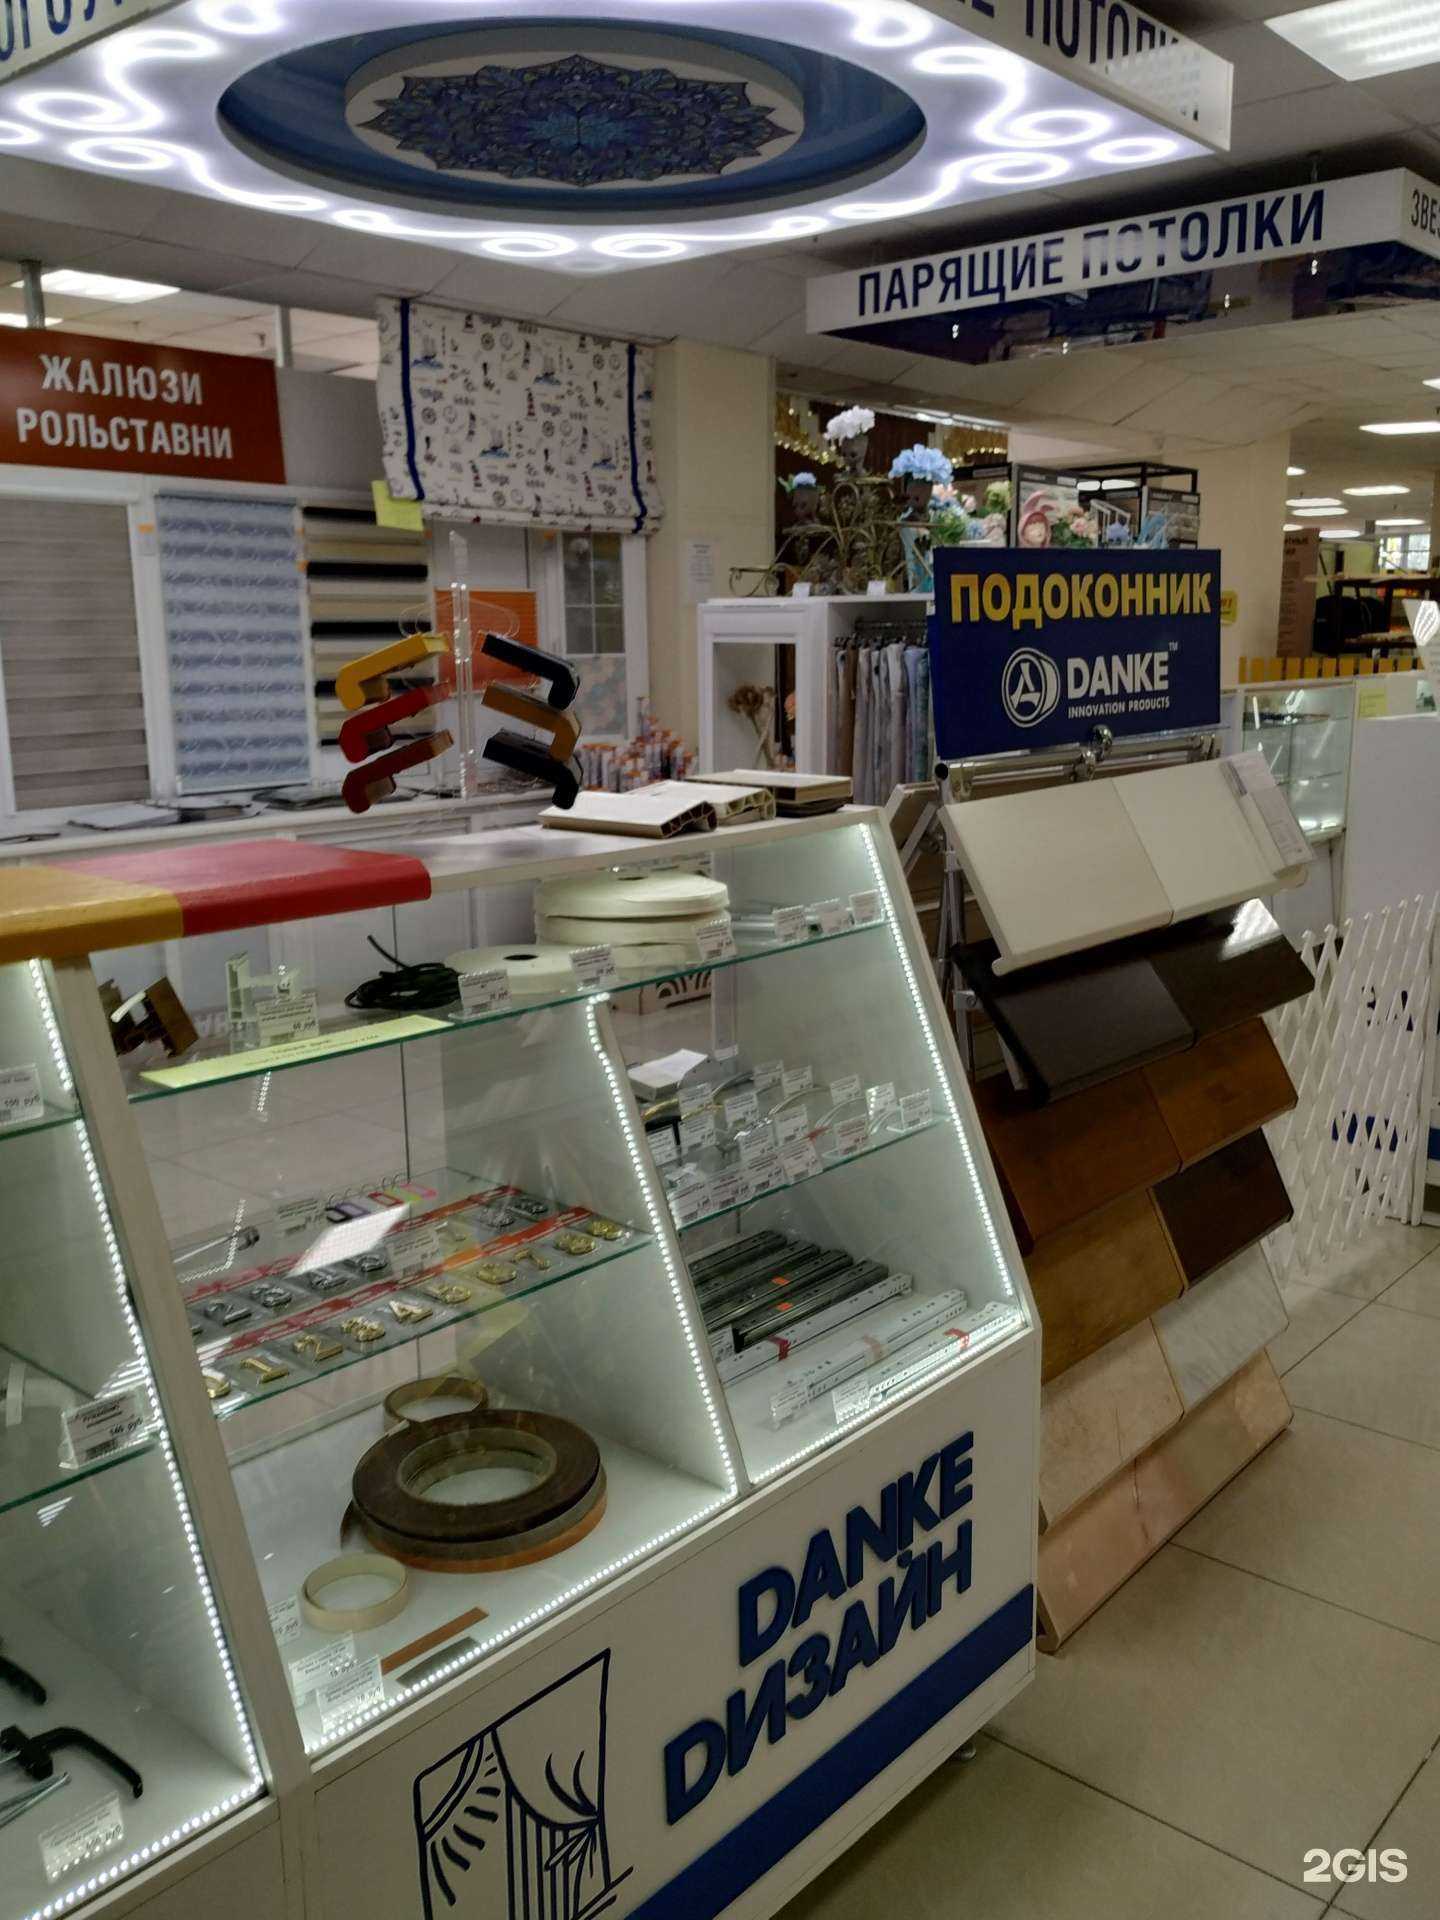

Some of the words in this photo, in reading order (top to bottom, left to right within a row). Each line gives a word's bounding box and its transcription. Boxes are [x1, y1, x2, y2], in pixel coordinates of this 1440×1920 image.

[1411, 189, 1440, 238] ЗВЕ
[858, 237, 1064, 317] ПАРЯЩИЕ
[1082, 189, 1325, 279] ПОТОЛКИ
[39, 354, 203, 405] ЖАЛЮЗИ
[16, 407, 233, 459] РОЛЬСТАВНИ
[950, 573, 1212, 629] ПОДОКОННИК
[1067, 651, 1169, 700] DANKE
[1068, 702, 1125, 719] INNOVATION
[1128, 696, 1170, 712] PRODUCTS
[738, 1431, 974, 1667] DANKE
